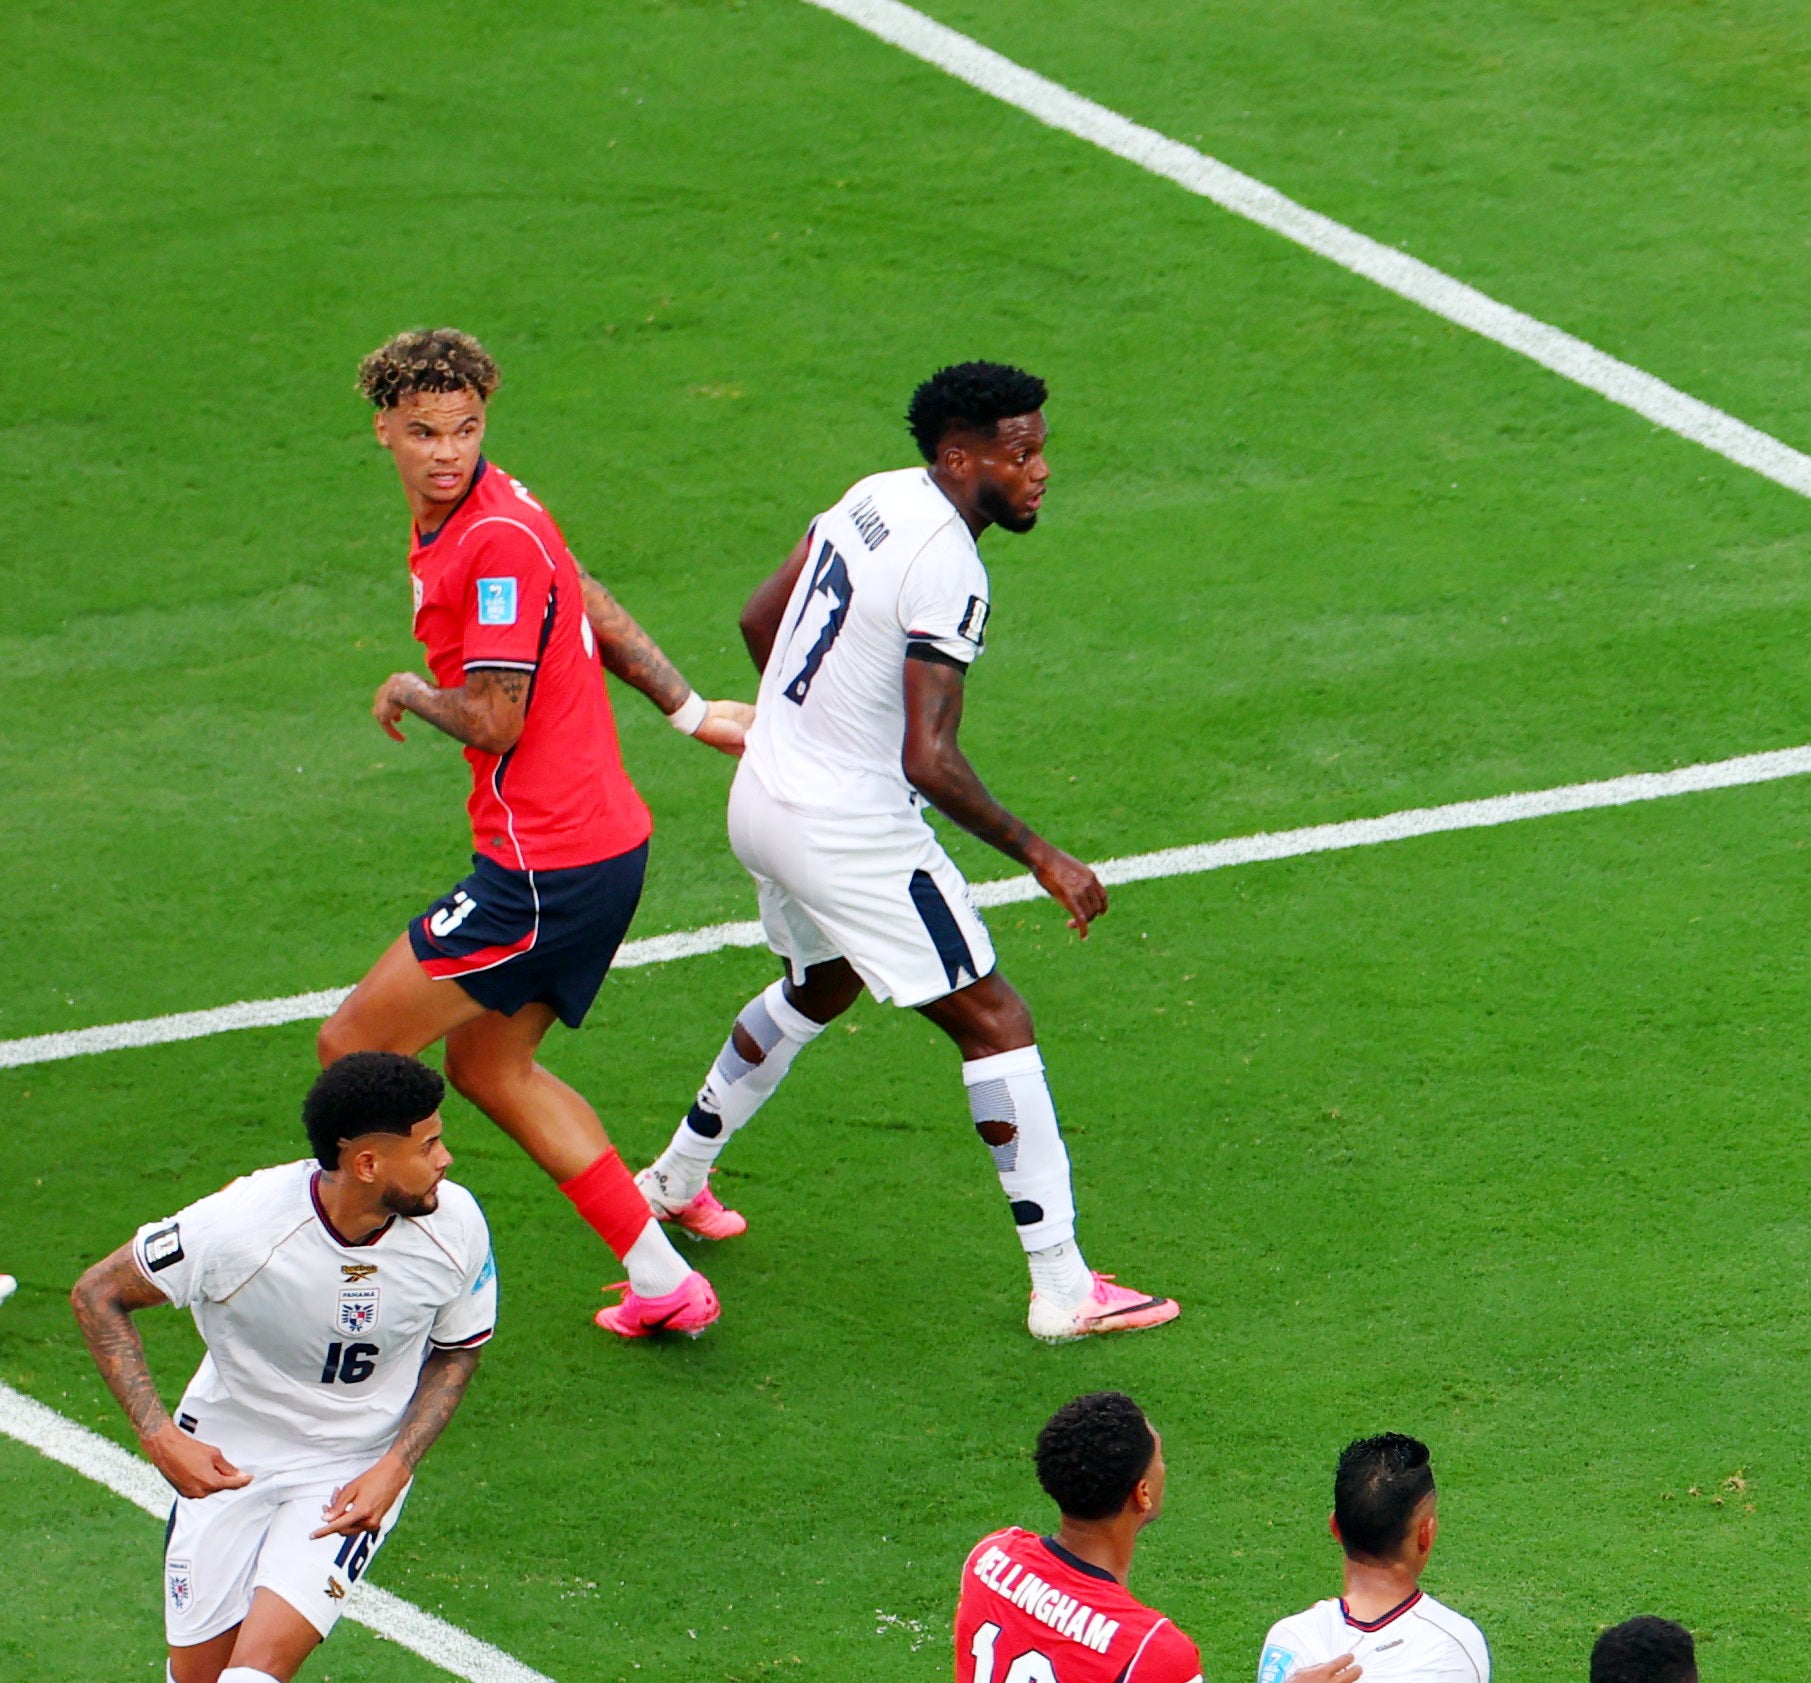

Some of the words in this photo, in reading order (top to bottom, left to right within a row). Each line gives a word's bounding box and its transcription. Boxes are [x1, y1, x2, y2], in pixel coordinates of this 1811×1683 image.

[778, 539, 854, 706] 17
[430, 890, 478, 937] 3
[321, 1342, 380, 1384] 16
[973, 1544, 1120, 1656] BELLINGHAM
